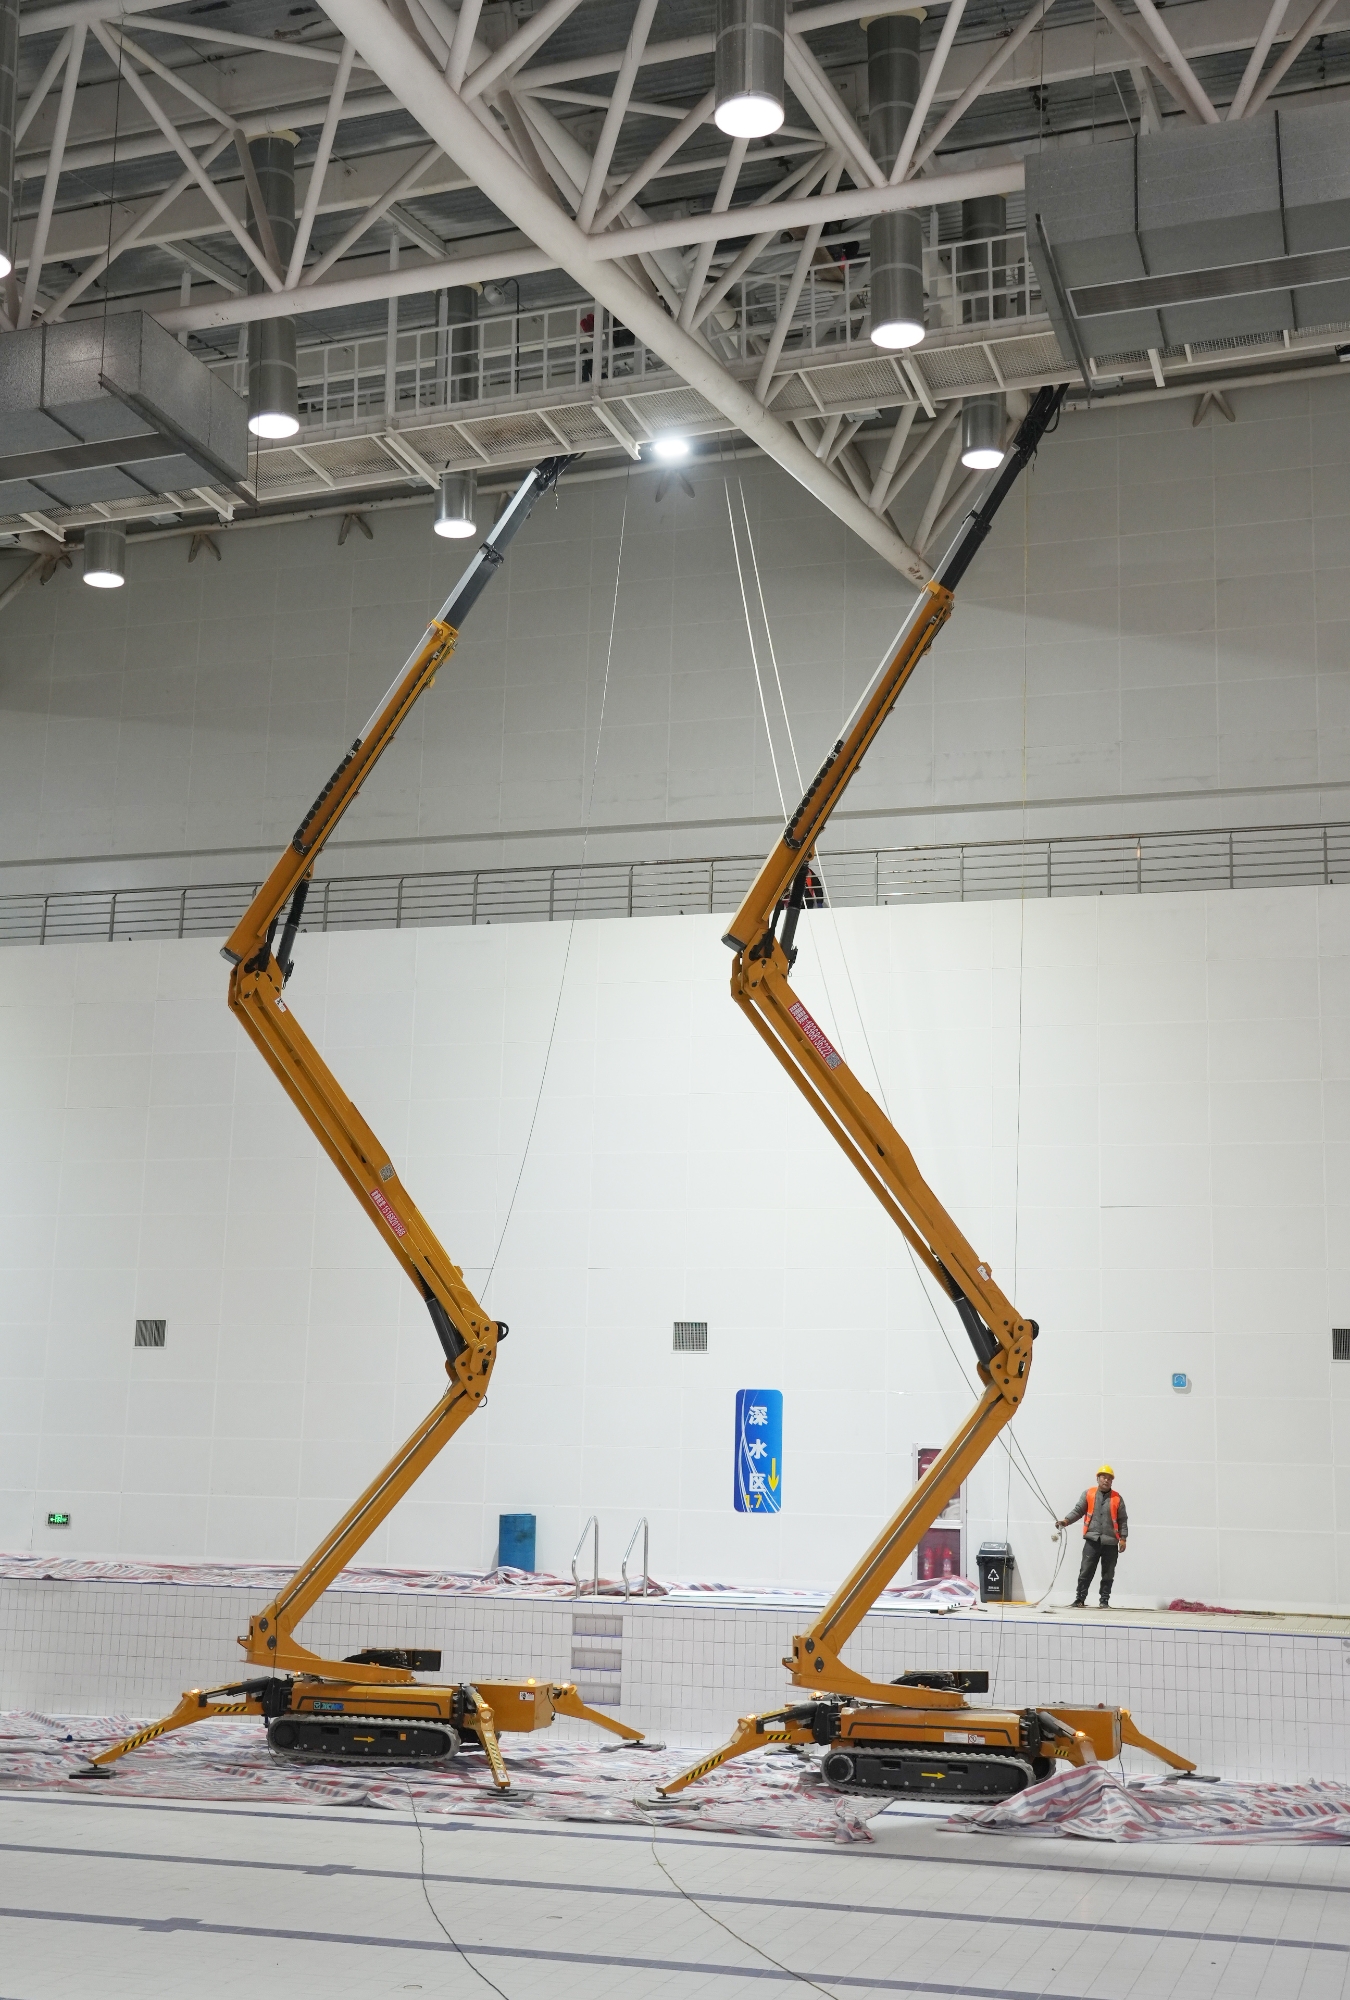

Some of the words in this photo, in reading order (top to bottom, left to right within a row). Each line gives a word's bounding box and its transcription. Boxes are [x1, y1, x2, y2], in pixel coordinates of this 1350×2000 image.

[748, 1405, 769, 1493] 深水区
[744, 1494, 763, 1509] 1.7
